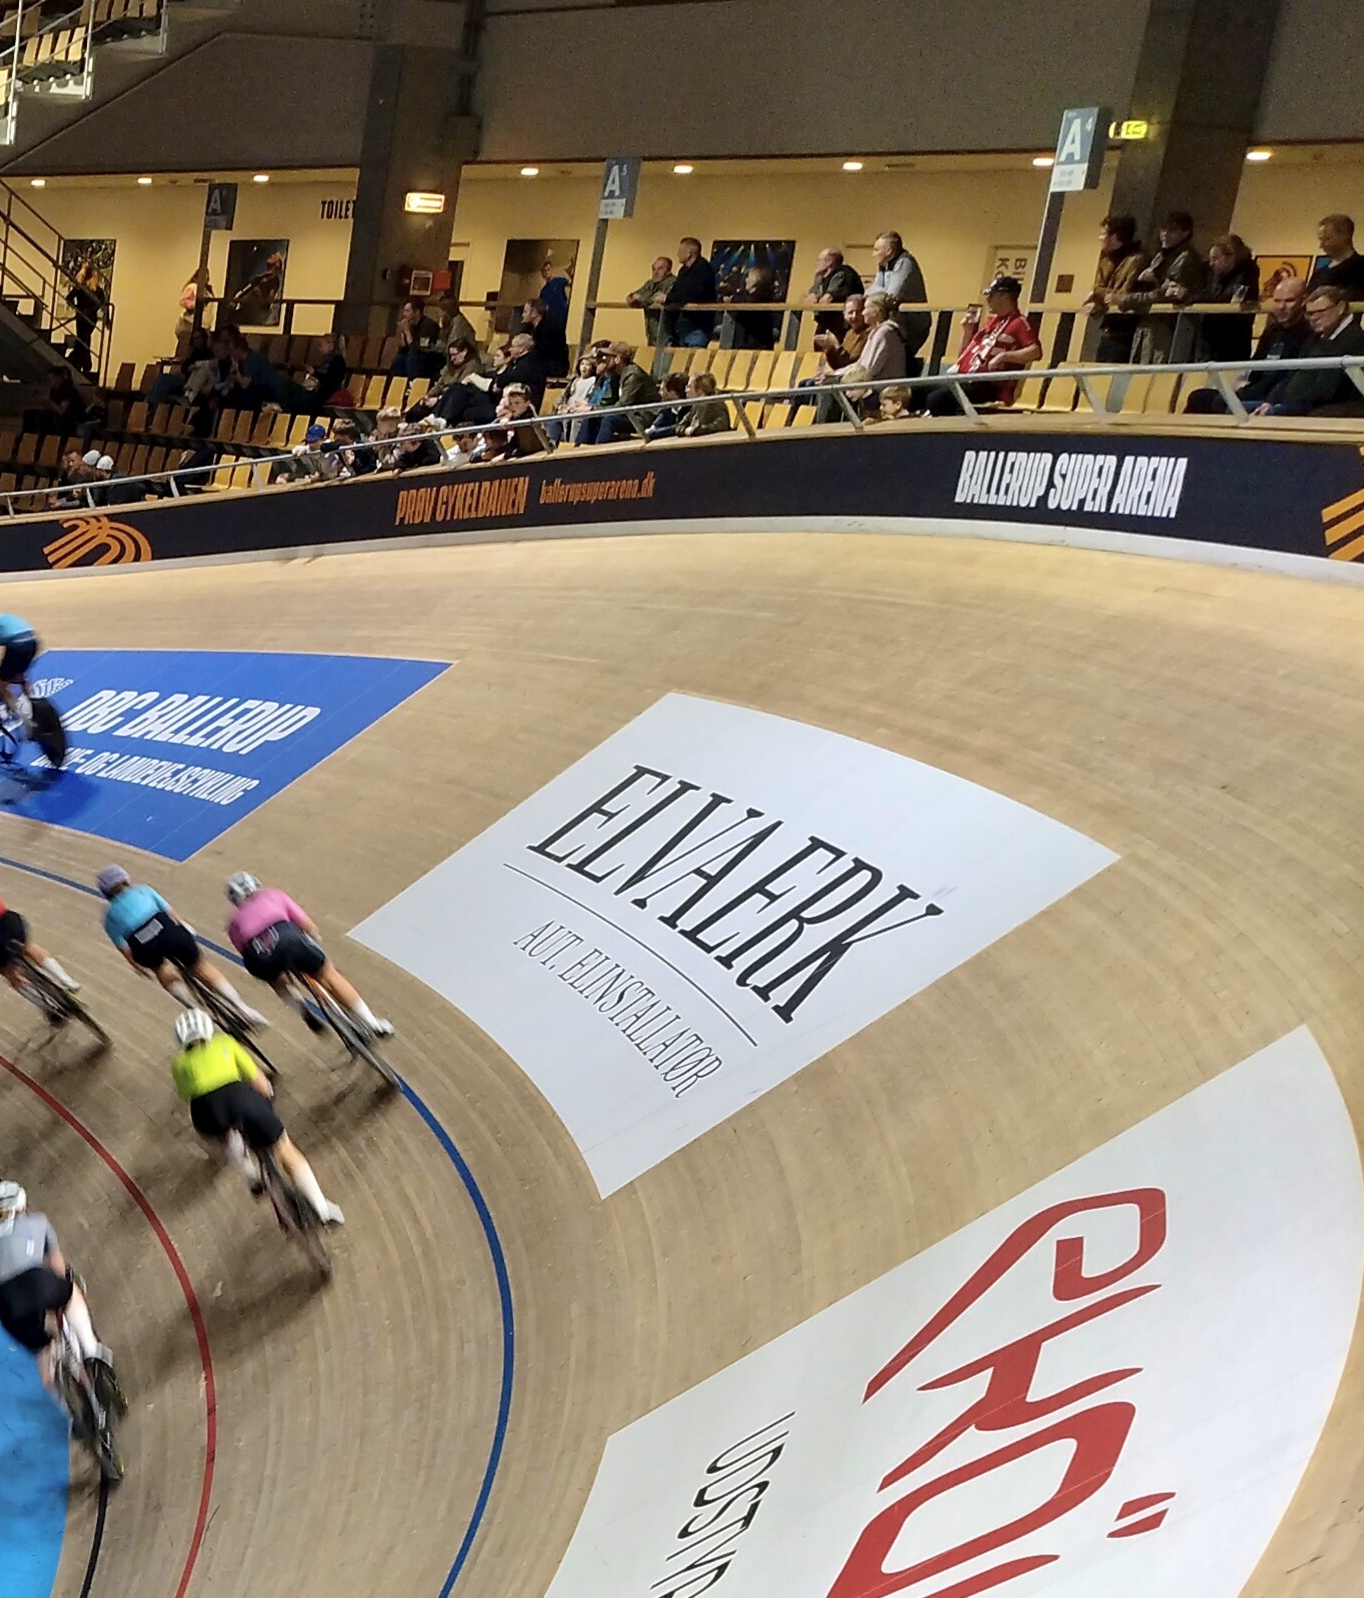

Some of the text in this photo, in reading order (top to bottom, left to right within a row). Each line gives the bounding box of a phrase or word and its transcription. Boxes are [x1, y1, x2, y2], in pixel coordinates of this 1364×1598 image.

[1056, 118, 1081, 162] A
[604, 165, 620, 197] A
[435, 476, 530, 522] CYKELBANEN
[954, 450, 1188, 518] BALLERUP SUPER ARENA
[112, 693, 322, 755] BALLERUP
